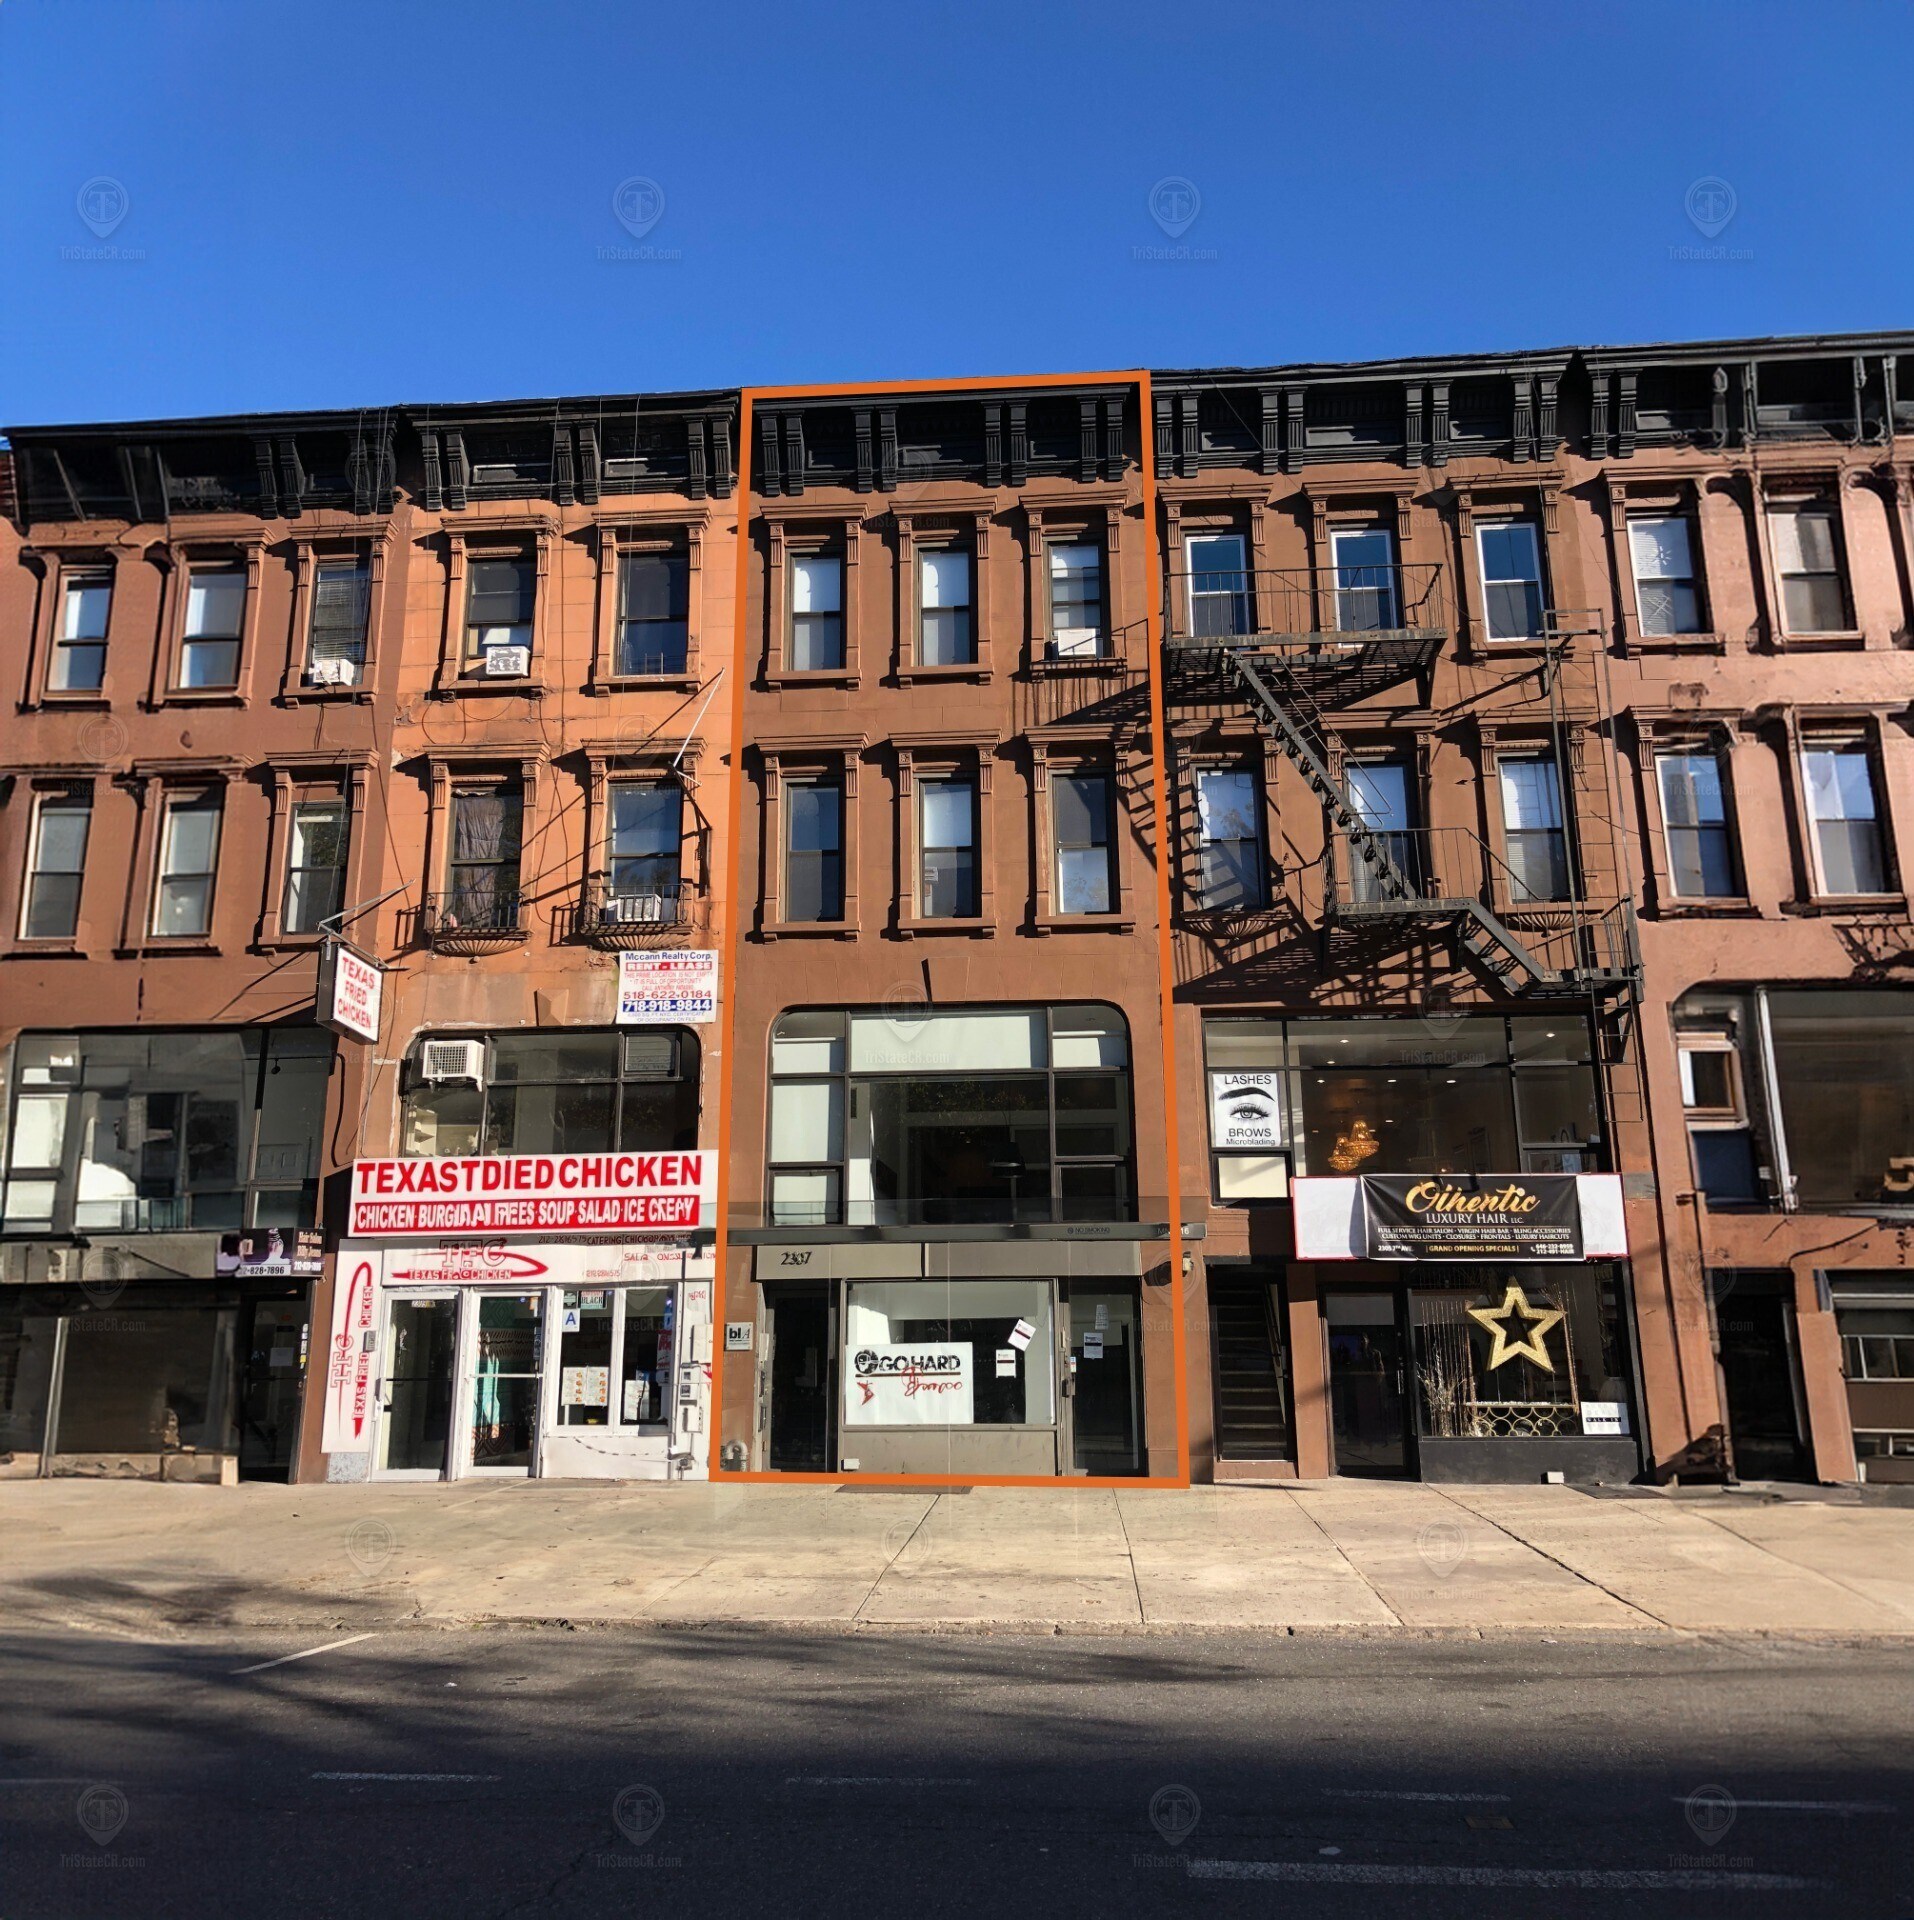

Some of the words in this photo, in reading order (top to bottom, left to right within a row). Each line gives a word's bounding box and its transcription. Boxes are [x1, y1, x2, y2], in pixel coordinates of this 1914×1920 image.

[625, 953, 660, 961] Mccann
[662, 952, 688, 961] Realty
[670, 962, 711, 970] LEASE
[342, 956, 375, 990] TEXAS
[345, 980, 367, 1006] FRIED
[624, 1000, 711, 1011] 718-918-9844
[337, 998, 371, 1029] CHICKEN
[1225, 1075, 1272, 1085] LASHES
[1228, 1128, 1272, 1137] BROWS
[1226, 1138, 1276, 1146] Microblading
[559, 1155, 702, 1189] CHICKEN
[357, 1204, 415, 1229] CHICKEN
[538, 1200, 576, 1225] SOUP
[577, 1199, 620, 1224] SALAD
[624, 1198, 645, 1223] ICE
[1426, 1213, 1473, 1224] LUXURY
[1477, 1214, 1509, 1224] HAIR
[587, 1235, 622, 1245] CATERING
[408, 1269, 439, 1280] TEXAS
[471, 1269, 513, 1280] CHICKEN
[358, 1286, 374, 1328] CHICKEN
[565, 1312, 576, 1325] A
[352, 1386, 367, 1419] TEXAS
